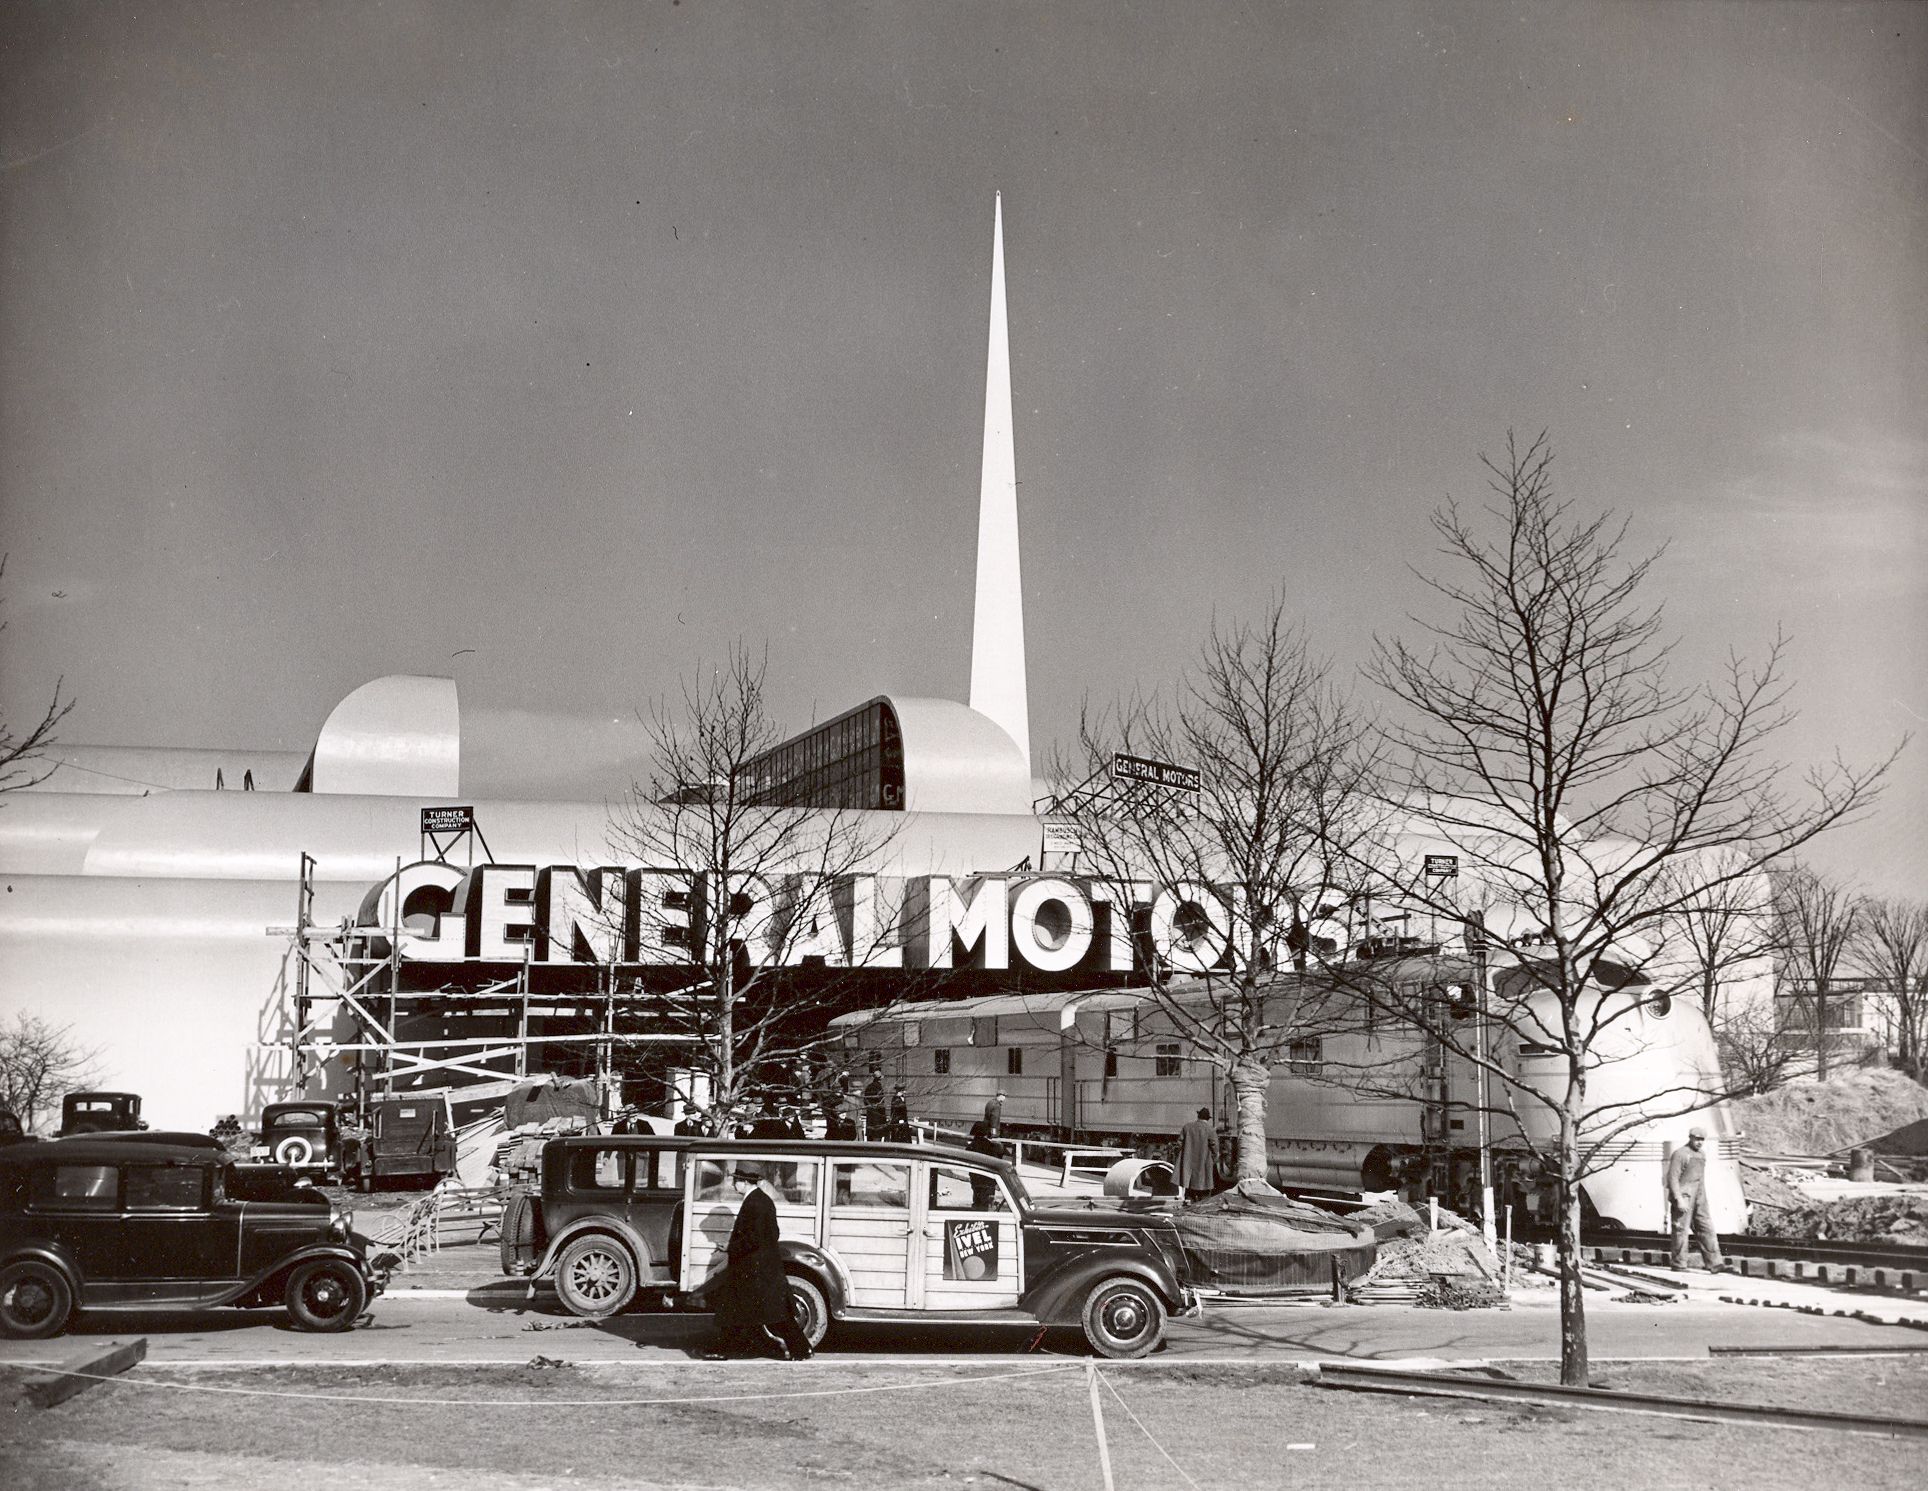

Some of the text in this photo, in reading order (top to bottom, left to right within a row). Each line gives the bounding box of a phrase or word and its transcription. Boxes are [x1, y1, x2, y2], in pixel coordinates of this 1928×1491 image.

[1116, 758, 1199, 789] GENERAL MOTORS
[376, 861, 1352, 972] GENERAL MOTORS
[955, 1229, 992, 1250] IVEL
[959, 1241, 994, 1259] NEW YORK
